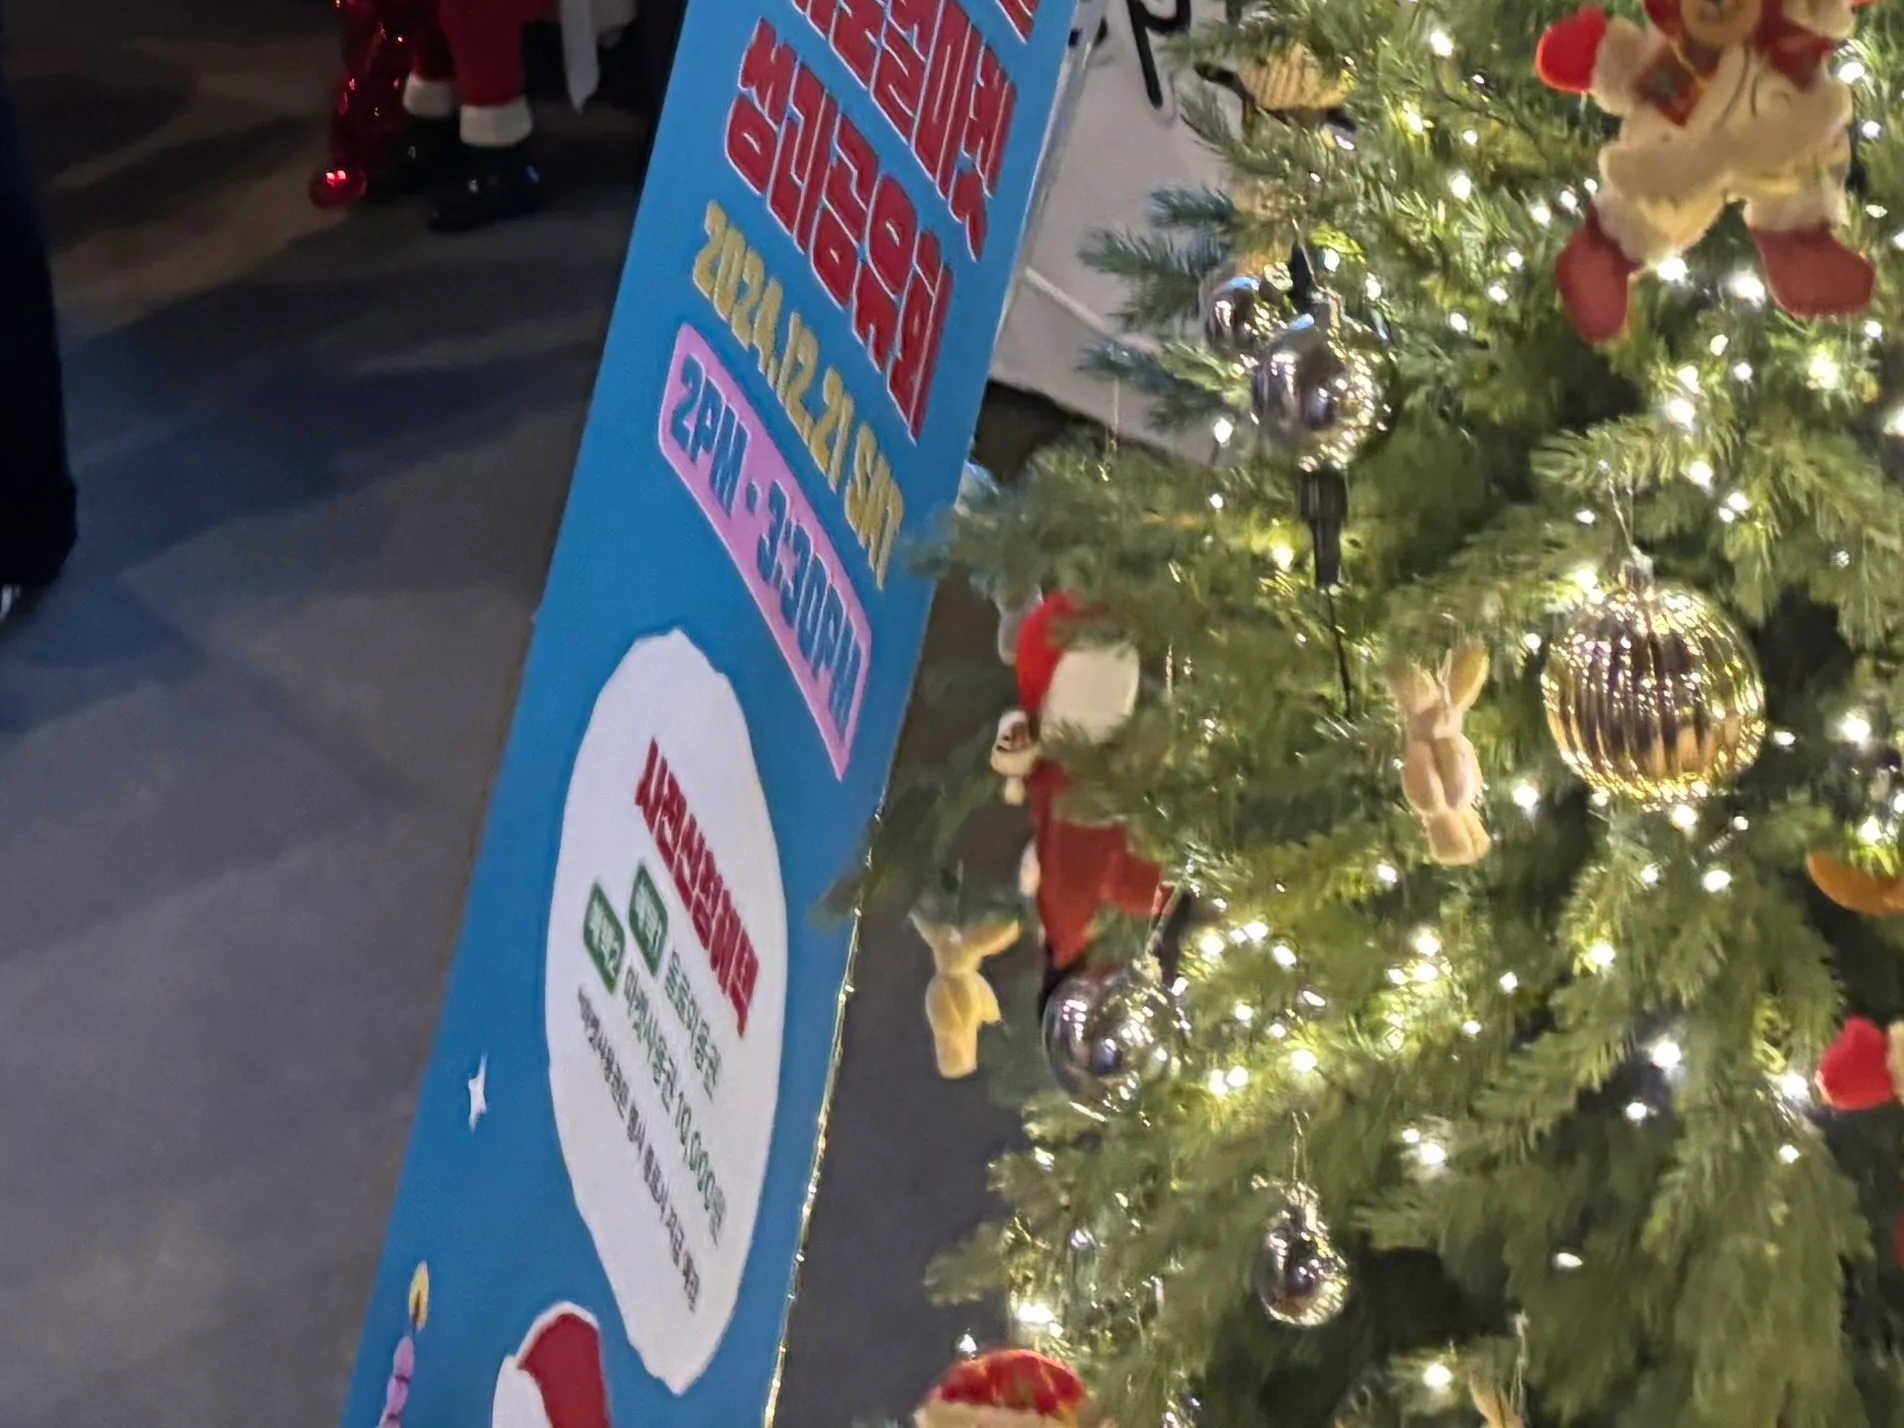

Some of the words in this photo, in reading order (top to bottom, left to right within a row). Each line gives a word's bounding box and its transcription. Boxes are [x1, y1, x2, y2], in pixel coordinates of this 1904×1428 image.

[692, 198, 854, 494] 2024.12.21
[843, 422, 904, 592] SAT
[725, 15, 954, 445] 성과공유회
